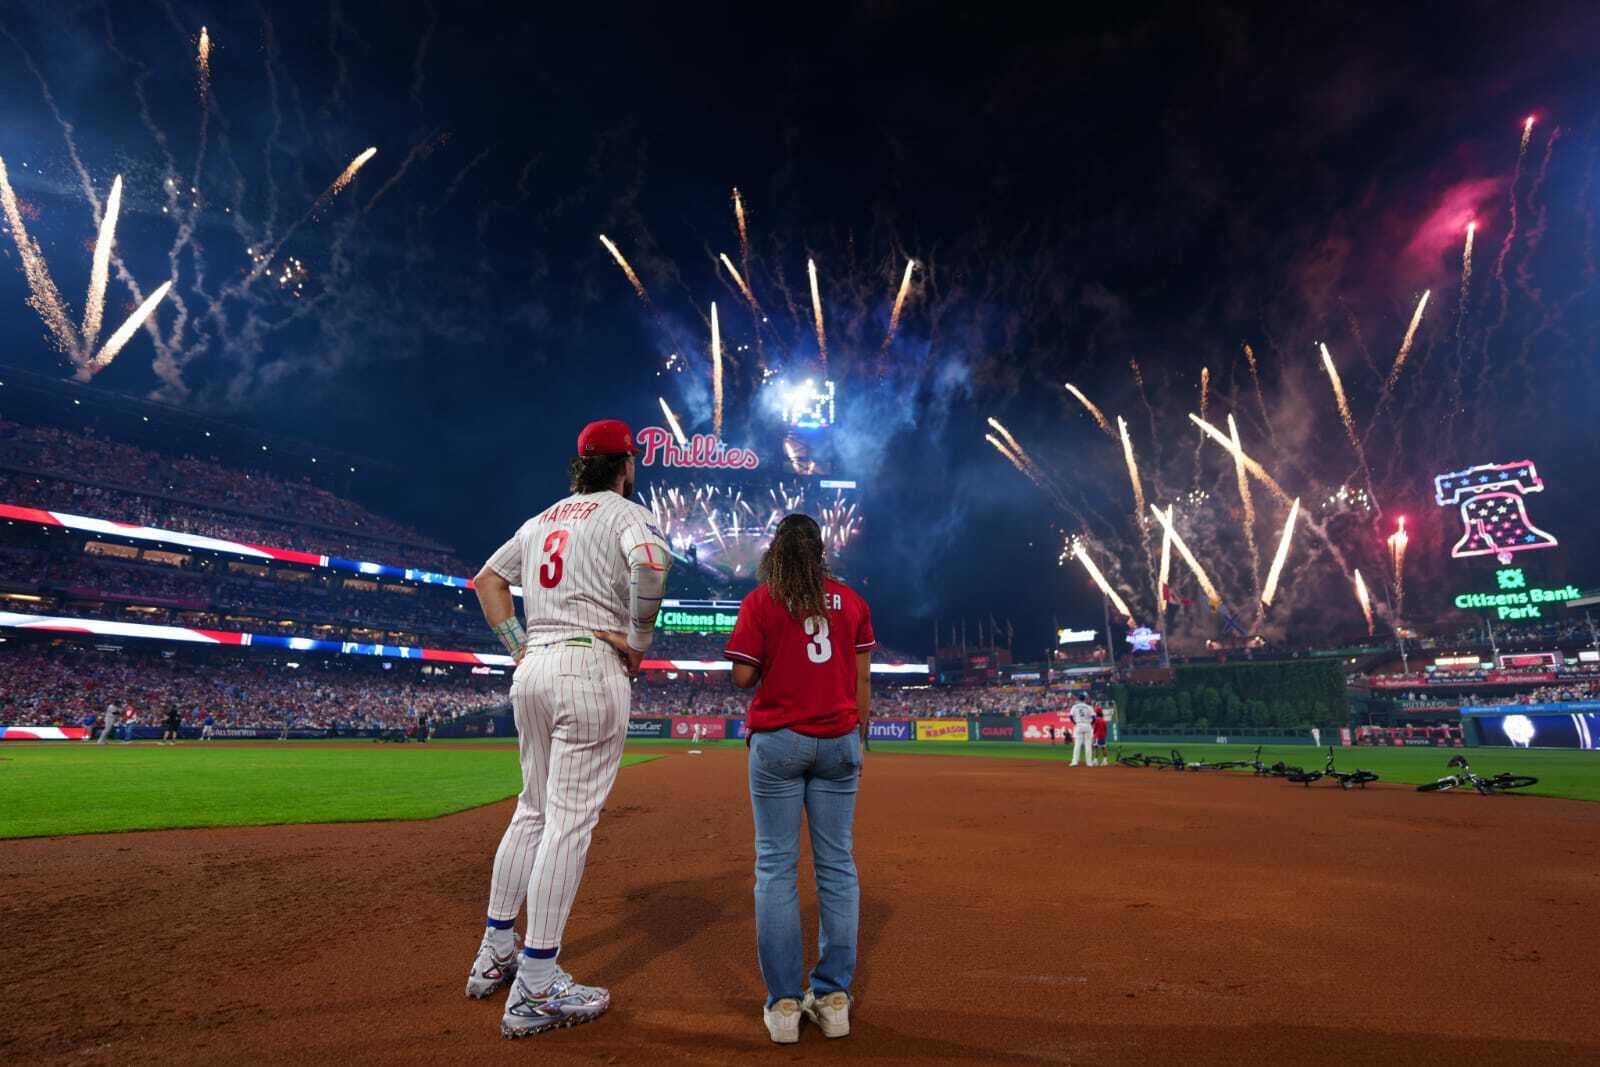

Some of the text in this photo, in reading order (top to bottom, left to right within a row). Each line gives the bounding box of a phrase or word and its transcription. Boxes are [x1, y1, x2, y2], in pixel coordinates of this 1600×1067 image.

[636, 426, 759, 469] Phillies
[540, 529, 569, 589] 3
[1455, 585, 1581, 608] Citizens Bank
[1497, 603, 1541, 620] Park
[663, 612, 714, 626] Citizens
[804, 615, 832, 664] 3
